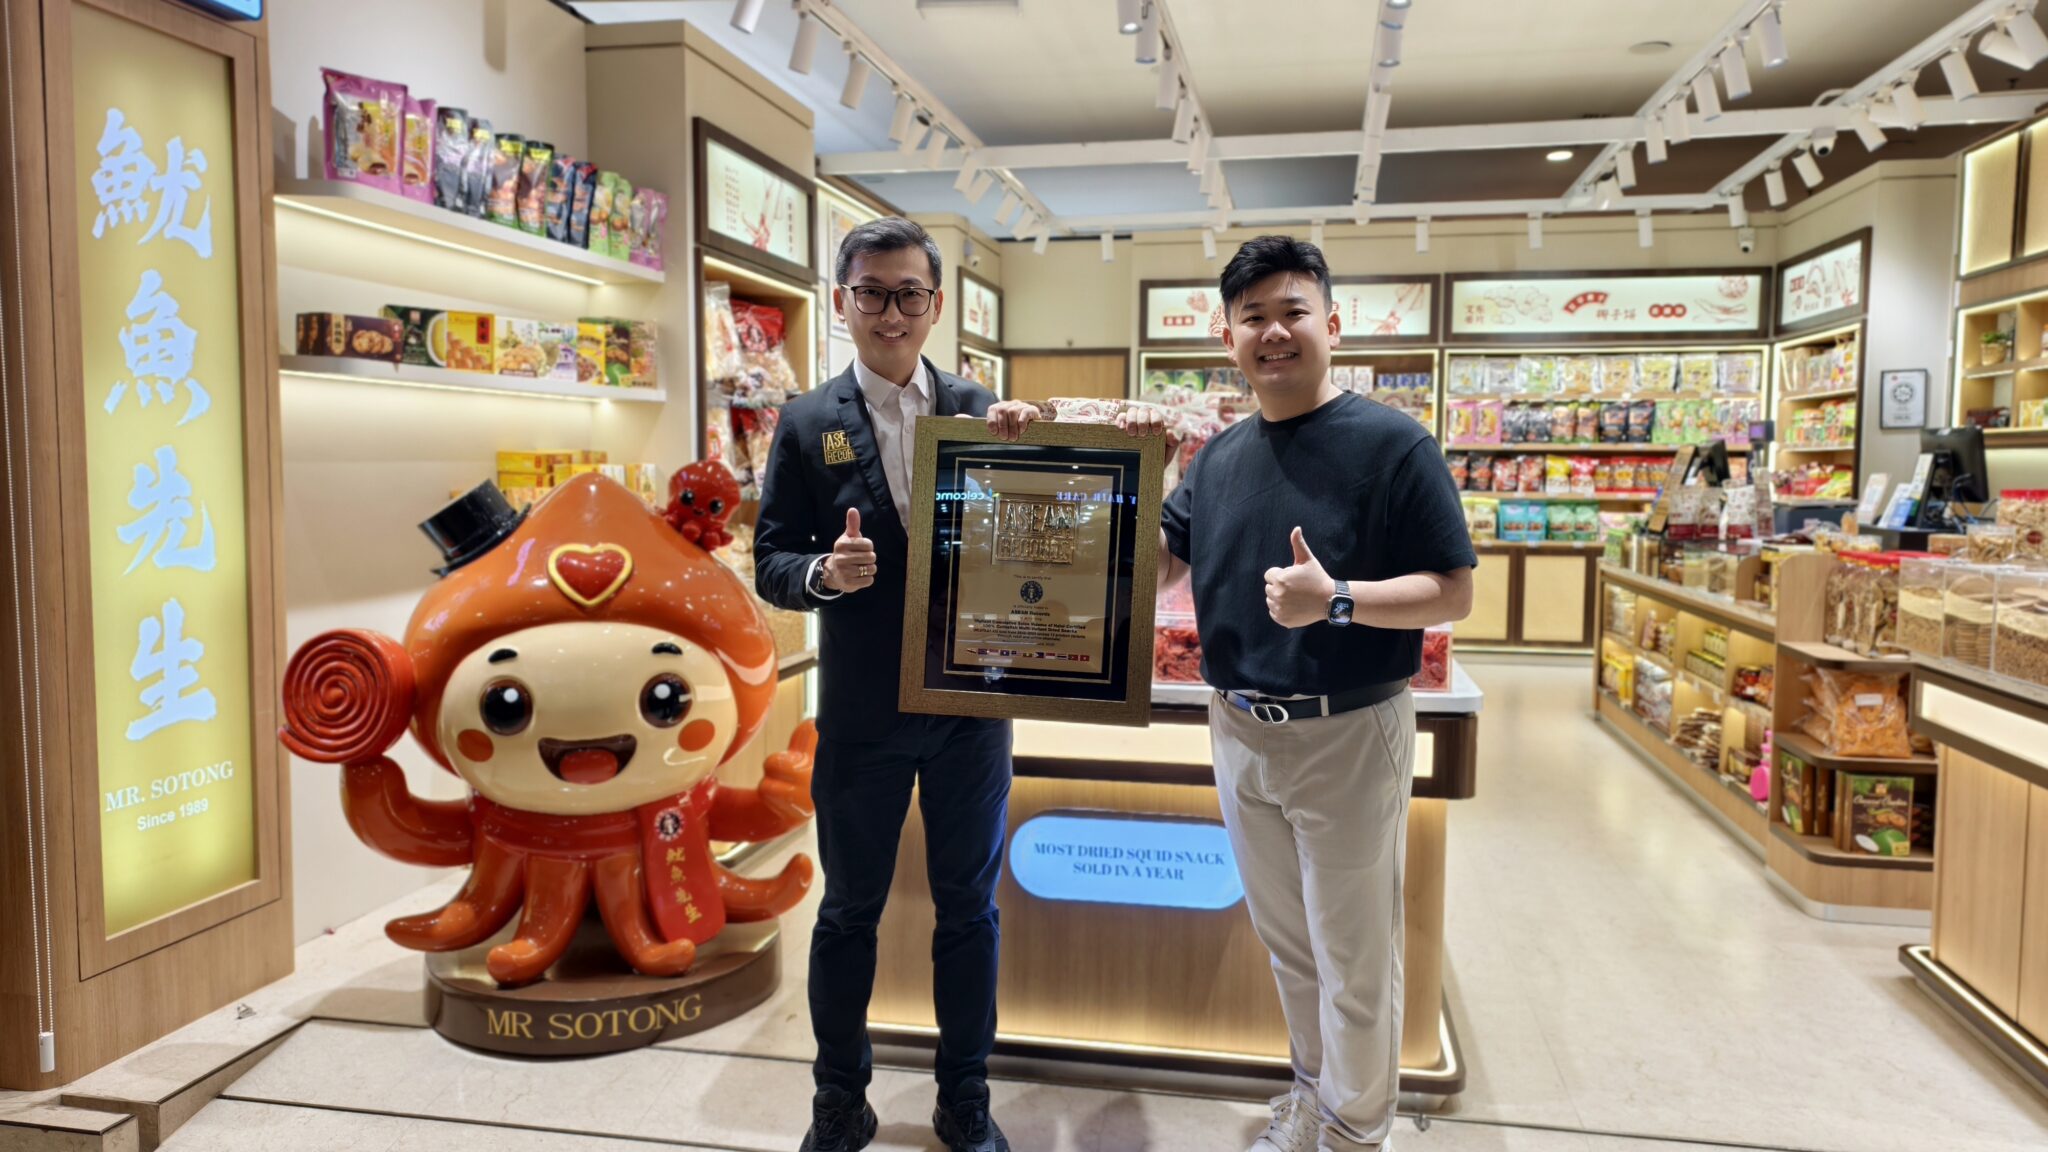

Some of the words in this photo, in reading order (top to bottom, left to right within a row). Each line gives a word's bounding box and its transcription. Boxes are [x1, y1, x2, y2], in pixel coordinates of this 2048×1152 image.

[91, 107, 217, 742] 魷魚先生
[826, 432, 851, 450] ASE
[827, 448, 857, 463] RECOR
[1002, 503, 1073, 531] ASEAN
[105, 786, 145, 812] MR.
[151, 761, 234, 800] SOTONG
[137, 810, 176, 832] Since
[179, 798, 209, 818] 1989
[1034, 842, 1076, 857] MOST
[1077, 844, 1124, 860] DRIED
[1126, 847, 1173, 864] SQUID
[1175, 851, 1225, 866] SNACK
[1072, 862, 1112, 876] SOLD
[1115, 864, 1130, 877] IN
[1130, 866, 1142, 878] A
[1144, 866, 1184, 881] YEAR
[487, 1008, 534, 1039] MR
[548, 993, 703, 1040] SOTONG
